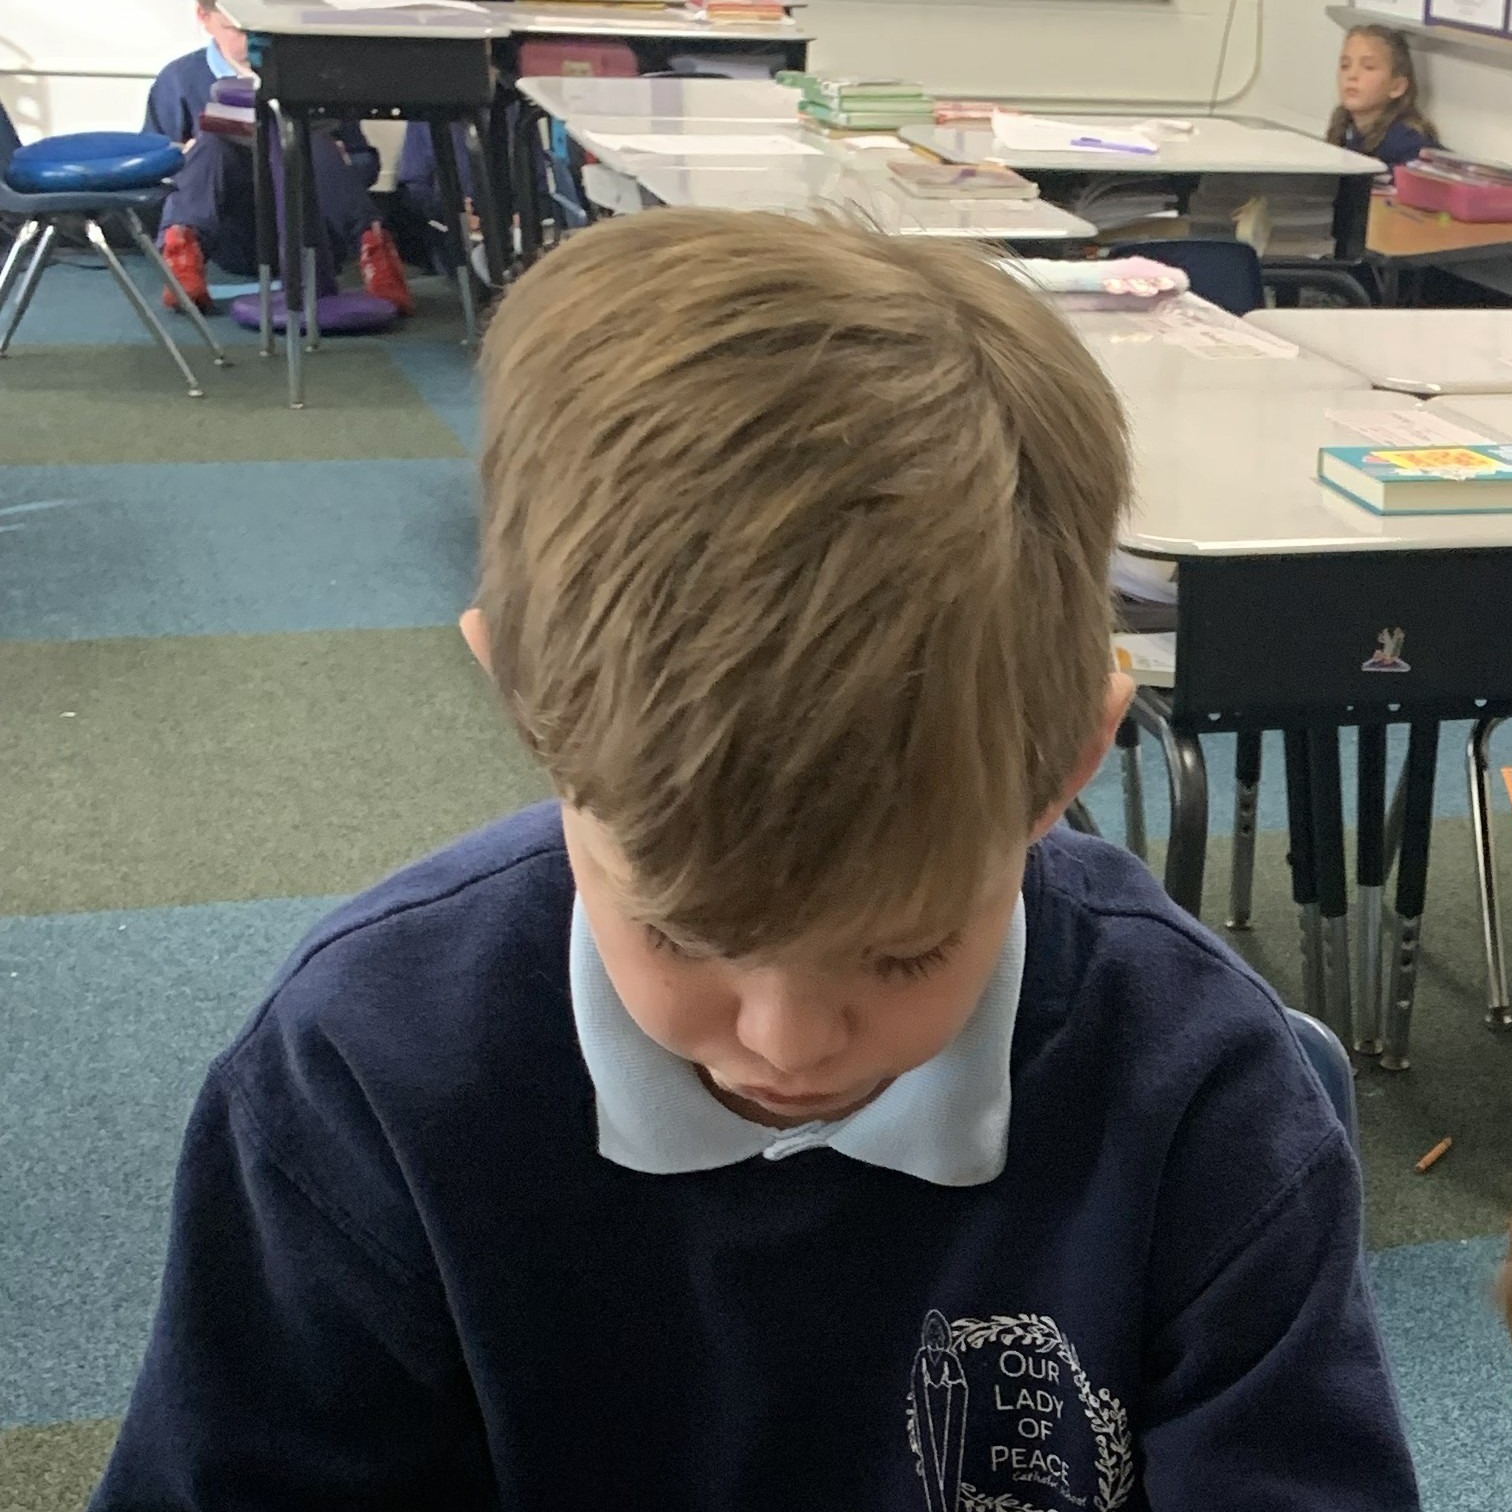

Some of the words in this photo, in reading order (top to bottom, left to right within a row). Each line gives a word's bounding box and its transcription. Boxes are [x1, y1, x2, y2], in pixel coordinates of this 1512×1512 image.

[999, 1350, 1060, 1386] OUR
[994, 1384, 1064, 1420] LADY
[1018, 1417, 1054, 1441] OF
[990, 1445, 1070, 1487] PEACE
